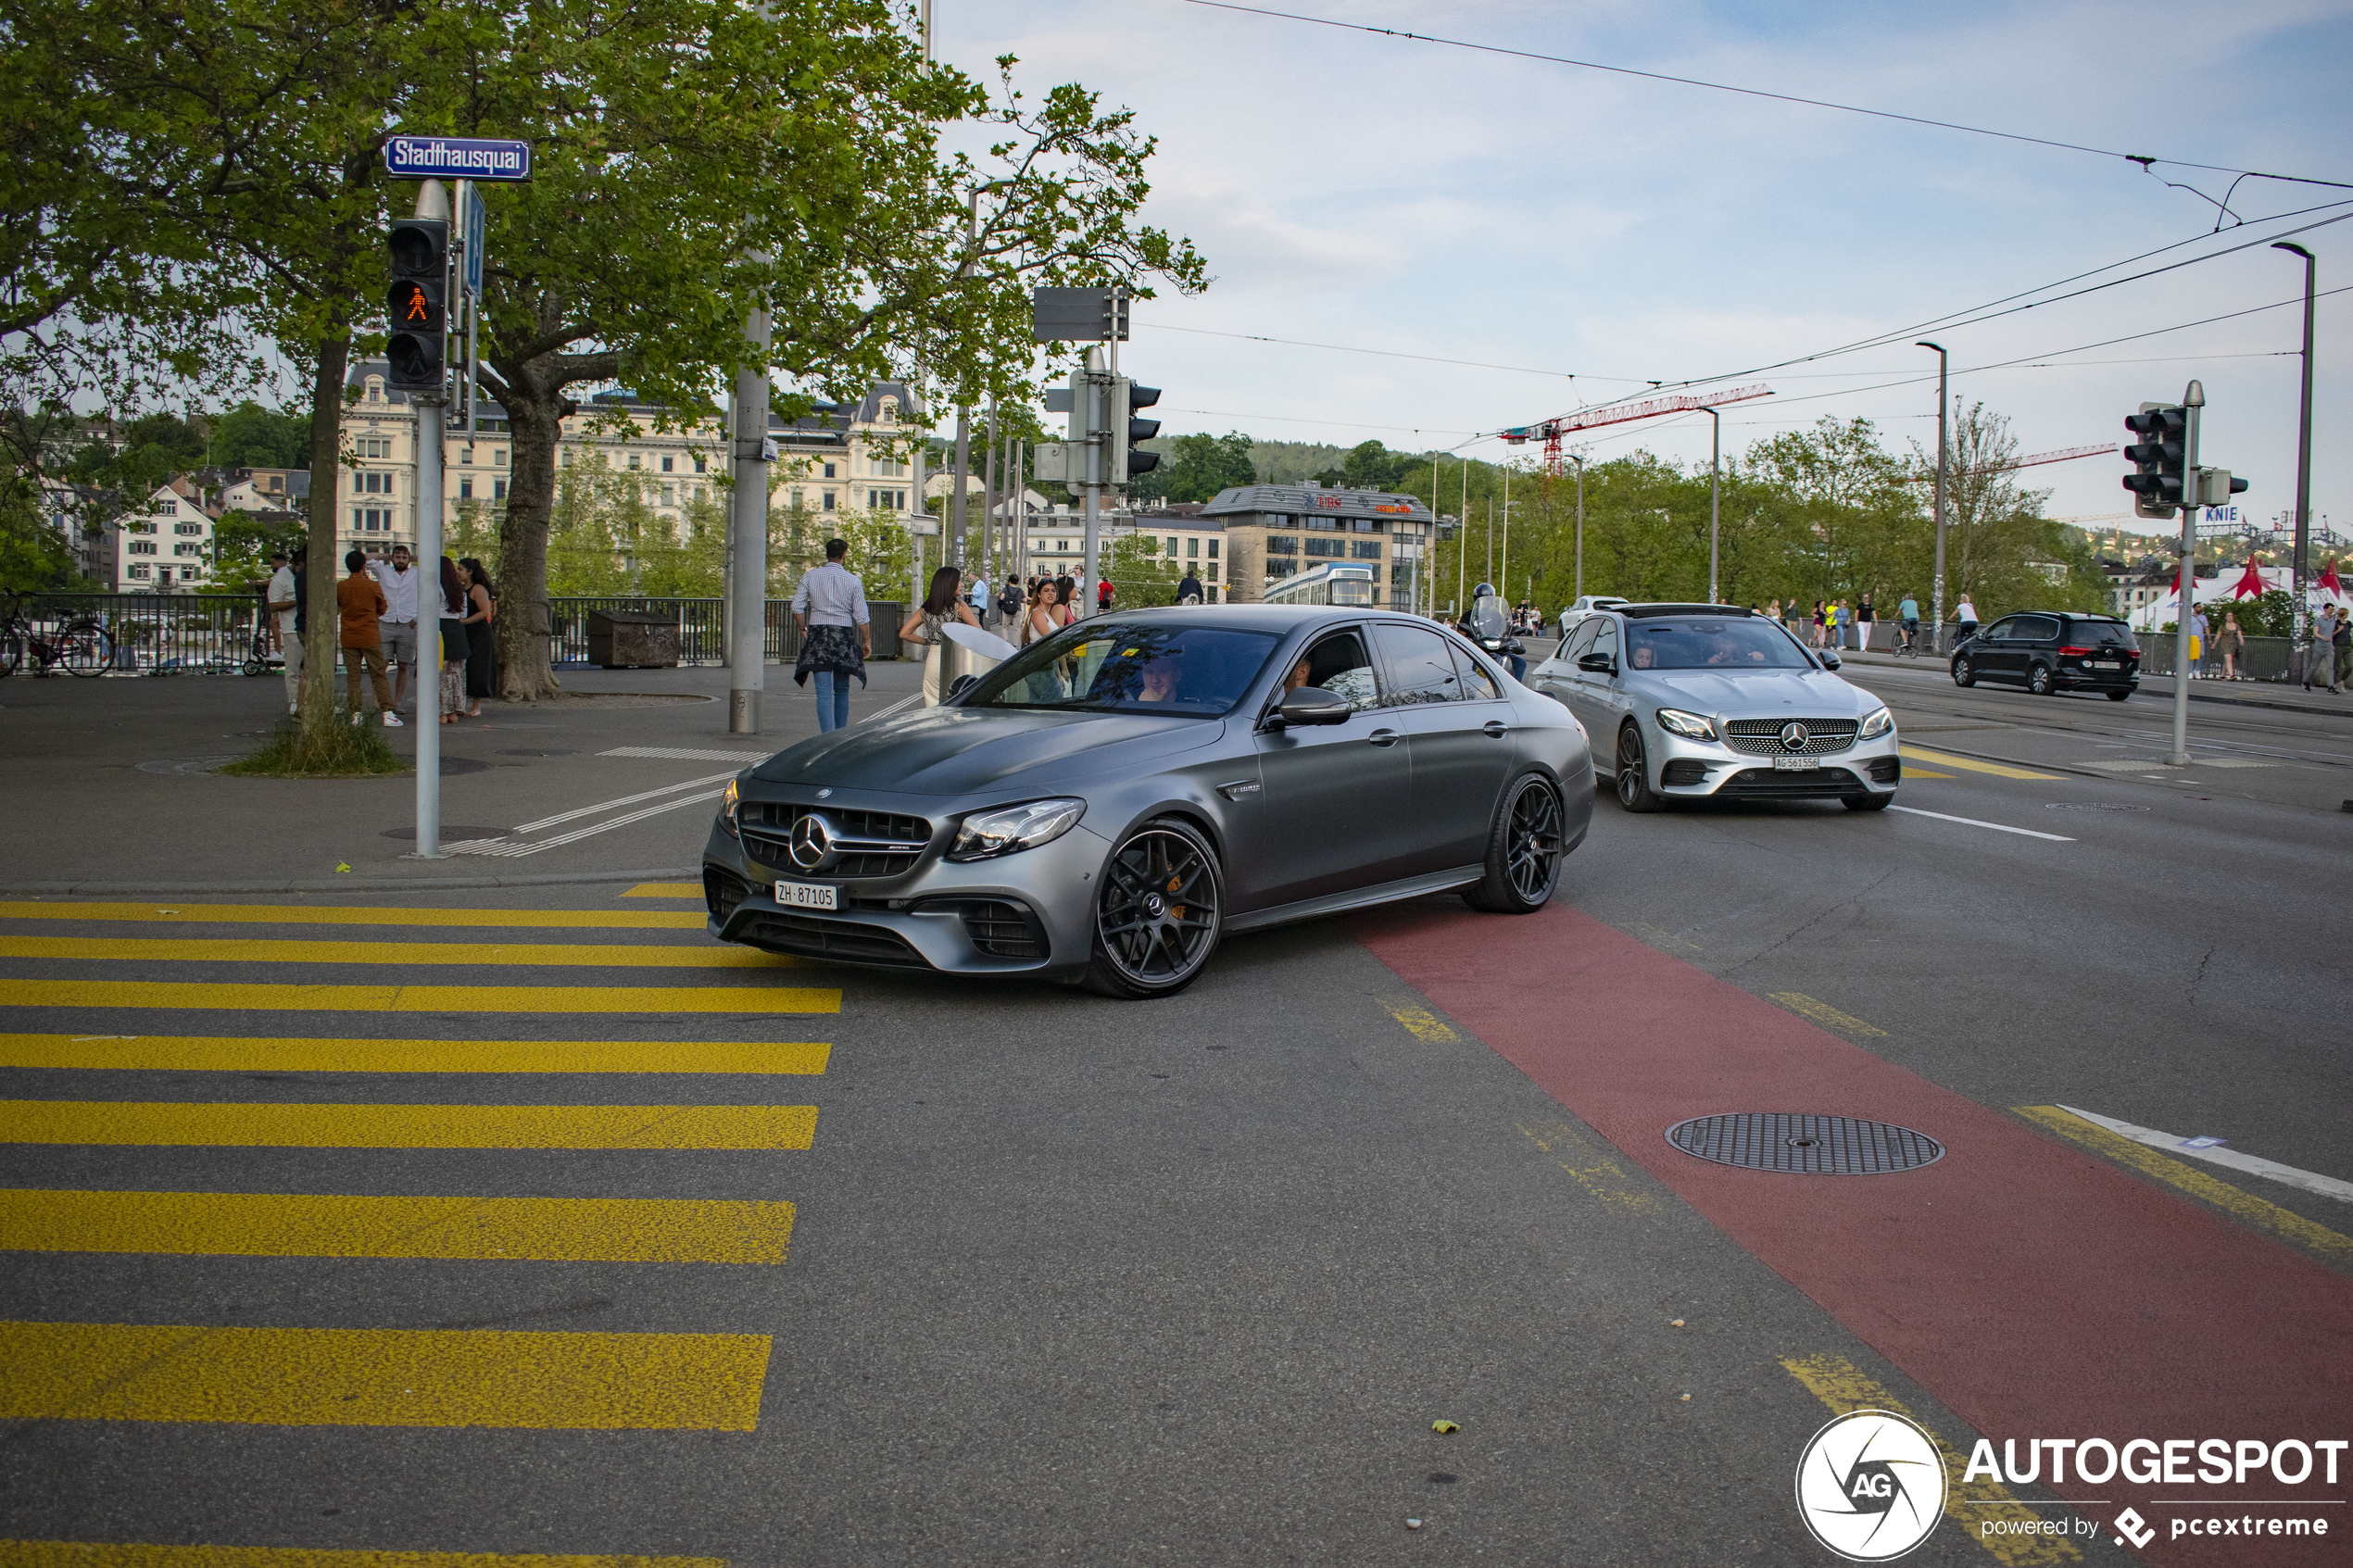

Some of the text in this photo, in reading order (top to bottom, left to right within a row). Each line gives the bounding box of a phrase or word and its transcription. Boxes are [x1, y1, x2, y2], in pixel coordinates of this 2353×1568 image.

[395, 140, 521, 174] Stadthausquai
[1318, 495, 1341, 508] UBS
[1397, 505, 1411, 514] city
[2206, 507, 2237, 521] KNIE
